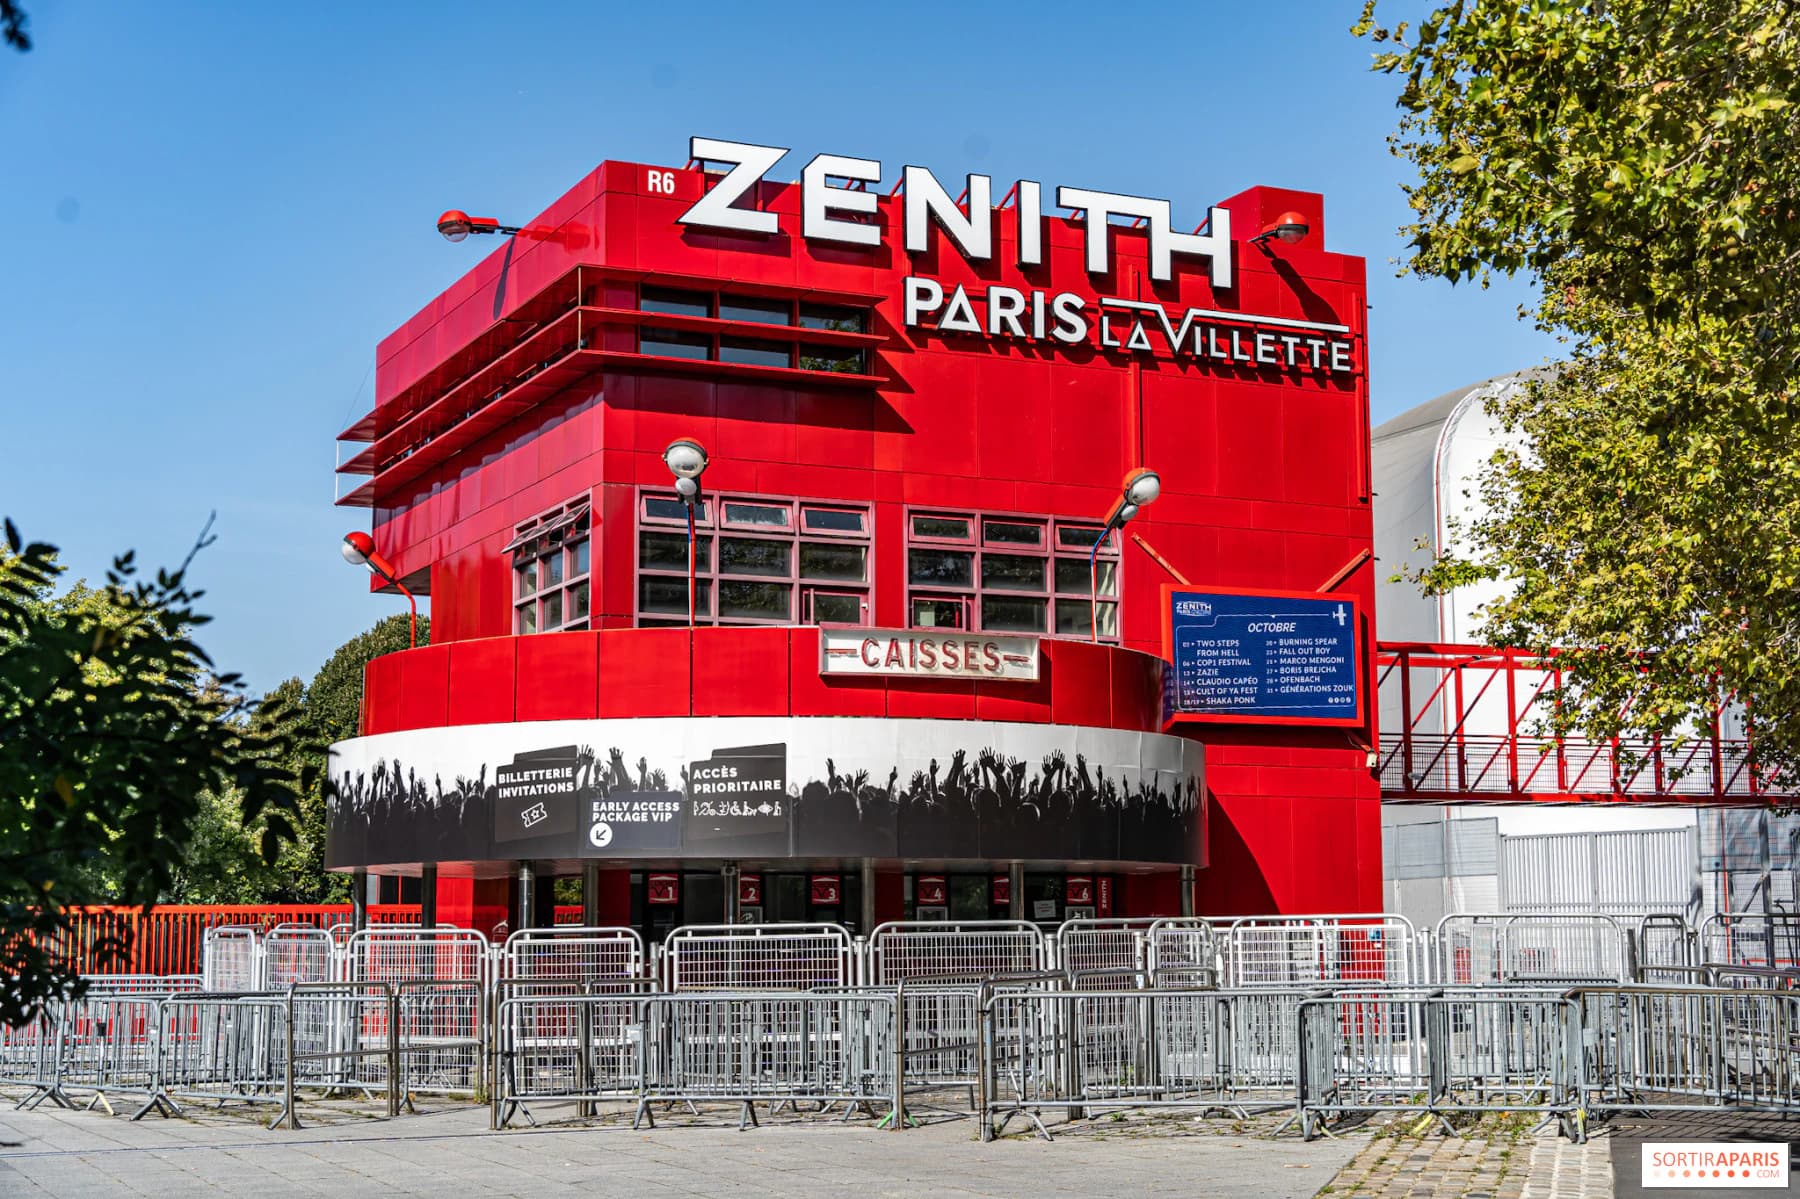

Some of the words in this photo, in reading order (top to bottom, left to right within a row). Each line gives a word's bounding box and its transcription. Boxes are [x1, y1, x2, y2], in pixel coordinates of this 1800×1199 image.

[648, 169, 675, 194] R6
[675, 136, 1232, 288] ZENITH
[904, 276, 1088, 343] PARIS
[1101, 315, 1152, 351] LA
[1157, 304, 1351, 372] VILLETTE
[1176, 601, 1212, 611] ZENITH
[1247, 622, 1297, 633] OCTOBRE
[1279, 638, 1313, 646] BURNING
[861, 637, 1001, 672] CAISSES
[1197, 649, 1219, 657] FROM
[1279, 657, 1307, 665] MARCO
[1197, 668, 1219, 676] ZAZIE
[1196, 678, 1231, 686] CLAUDIO
[1233, 676, 1258, 685] CAPÉO
[1280, 684, 1332, 693] GÉNÉRATIONS
[1333, 684, 1354, 692] ZOUK
[1206, 697, 1232, 705] SHAKA
[1234, 696, 1256, 704] PONK
[498, 767, 573, 784] BILLETTERIE
[693, 765, 738, 780] ACCÈS
[498, 782, 574, 799] INVITATIONS
[693, 780, 782, 794] PRIORITAIRE
[592, 802, 630, 812] EARLY
[632, 802, 680, 812] ACCESS
[592, 812, 649, 822] PACKAGE
[651, 812, 673, 822] VIP
[748, 887, 756, 900] 2
[828, 888, 836, 900] 3
[934, 888, 942, 900] 4
[1082, 887, 1089, 900] 6
